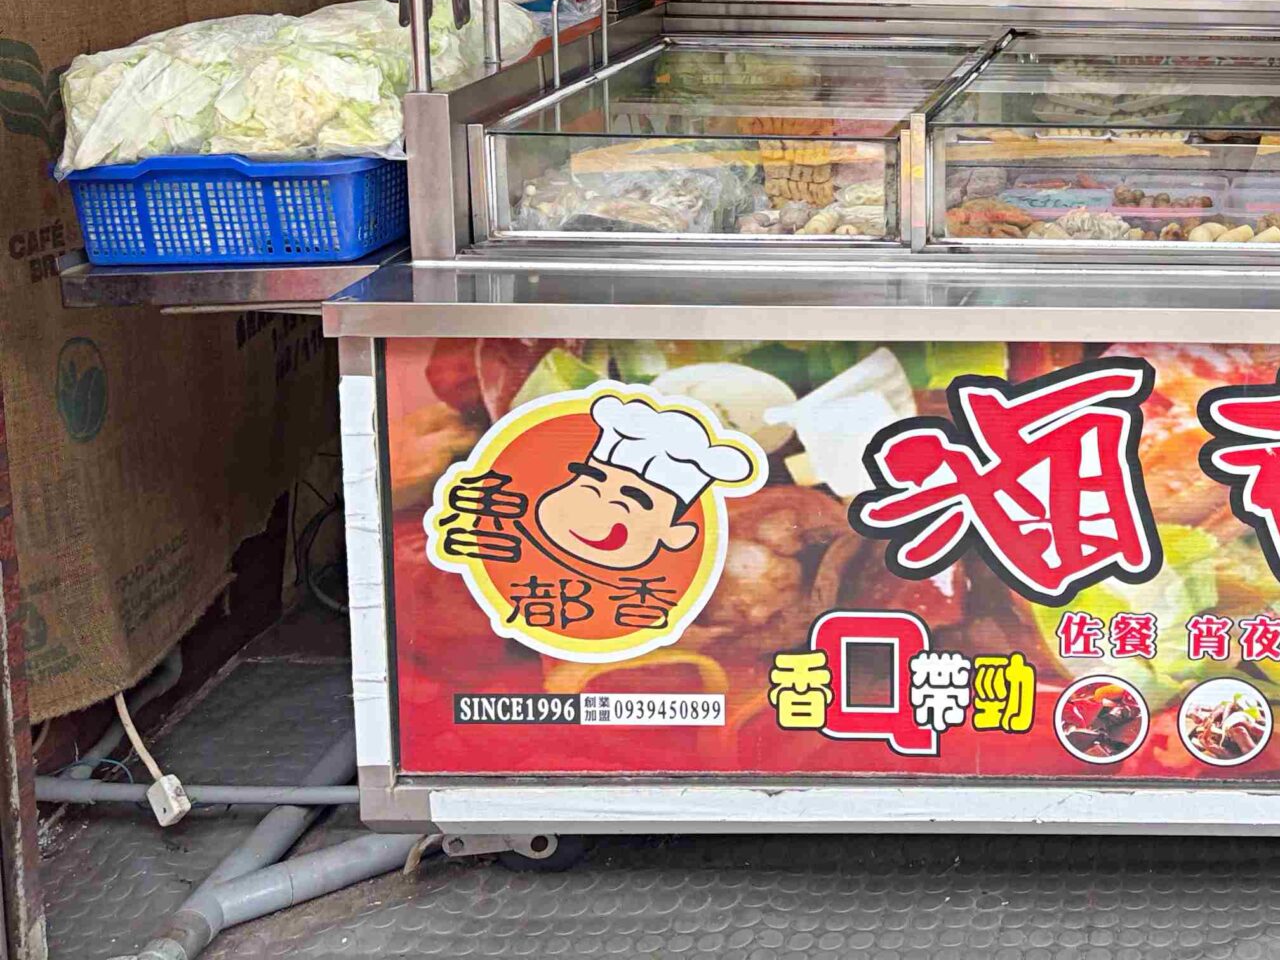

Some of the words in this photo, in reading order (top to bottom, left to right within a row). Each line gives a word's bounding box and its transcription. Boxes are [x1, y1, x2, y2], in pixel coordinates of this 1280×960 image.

[1057, 611, 1158, 661] 佐餐
[460, 697, 575, 721] SINCE1996
[614, 699, 721, 720] 0939450899
